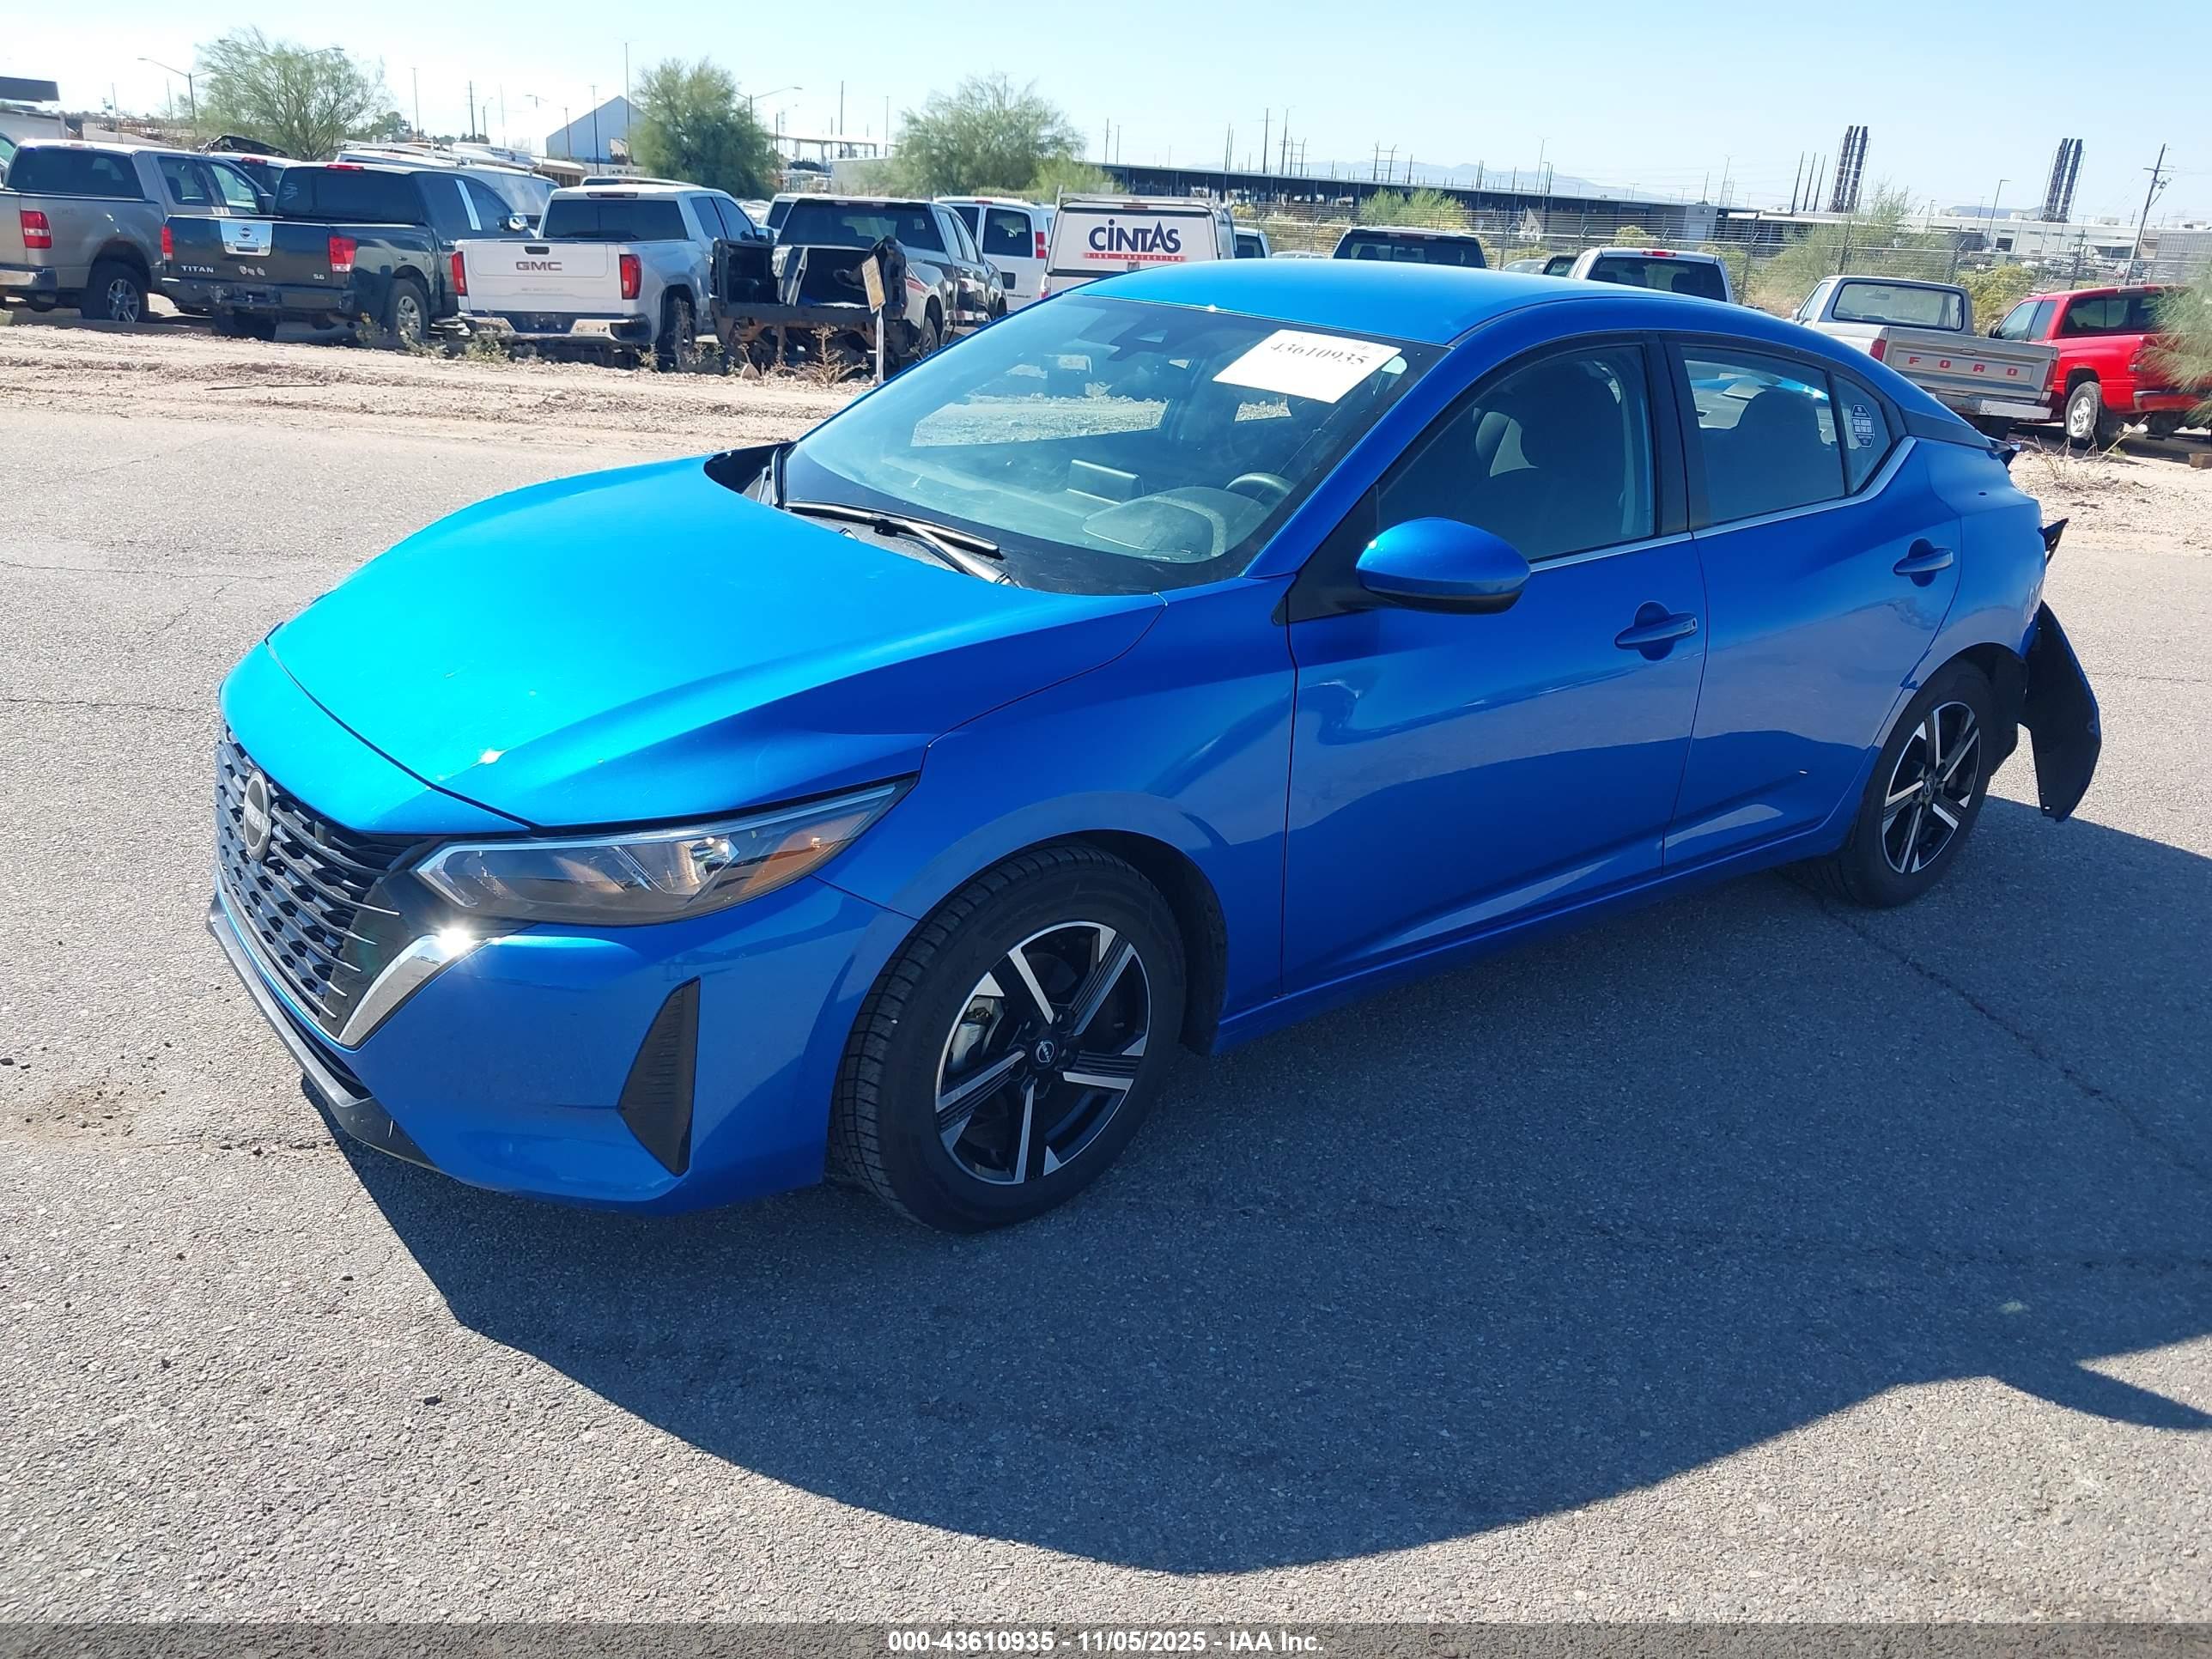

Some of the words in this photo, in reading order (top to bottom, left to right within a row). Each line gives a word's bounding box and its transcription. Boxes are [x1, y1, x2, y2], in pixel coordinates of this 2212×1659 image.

[180, 264, 215, 274] TITAN
[515, 260, 562, 271] GMC
[1270, 343, 1370, 365] 43610935
[1908, 356, 2019, 377] FORD
